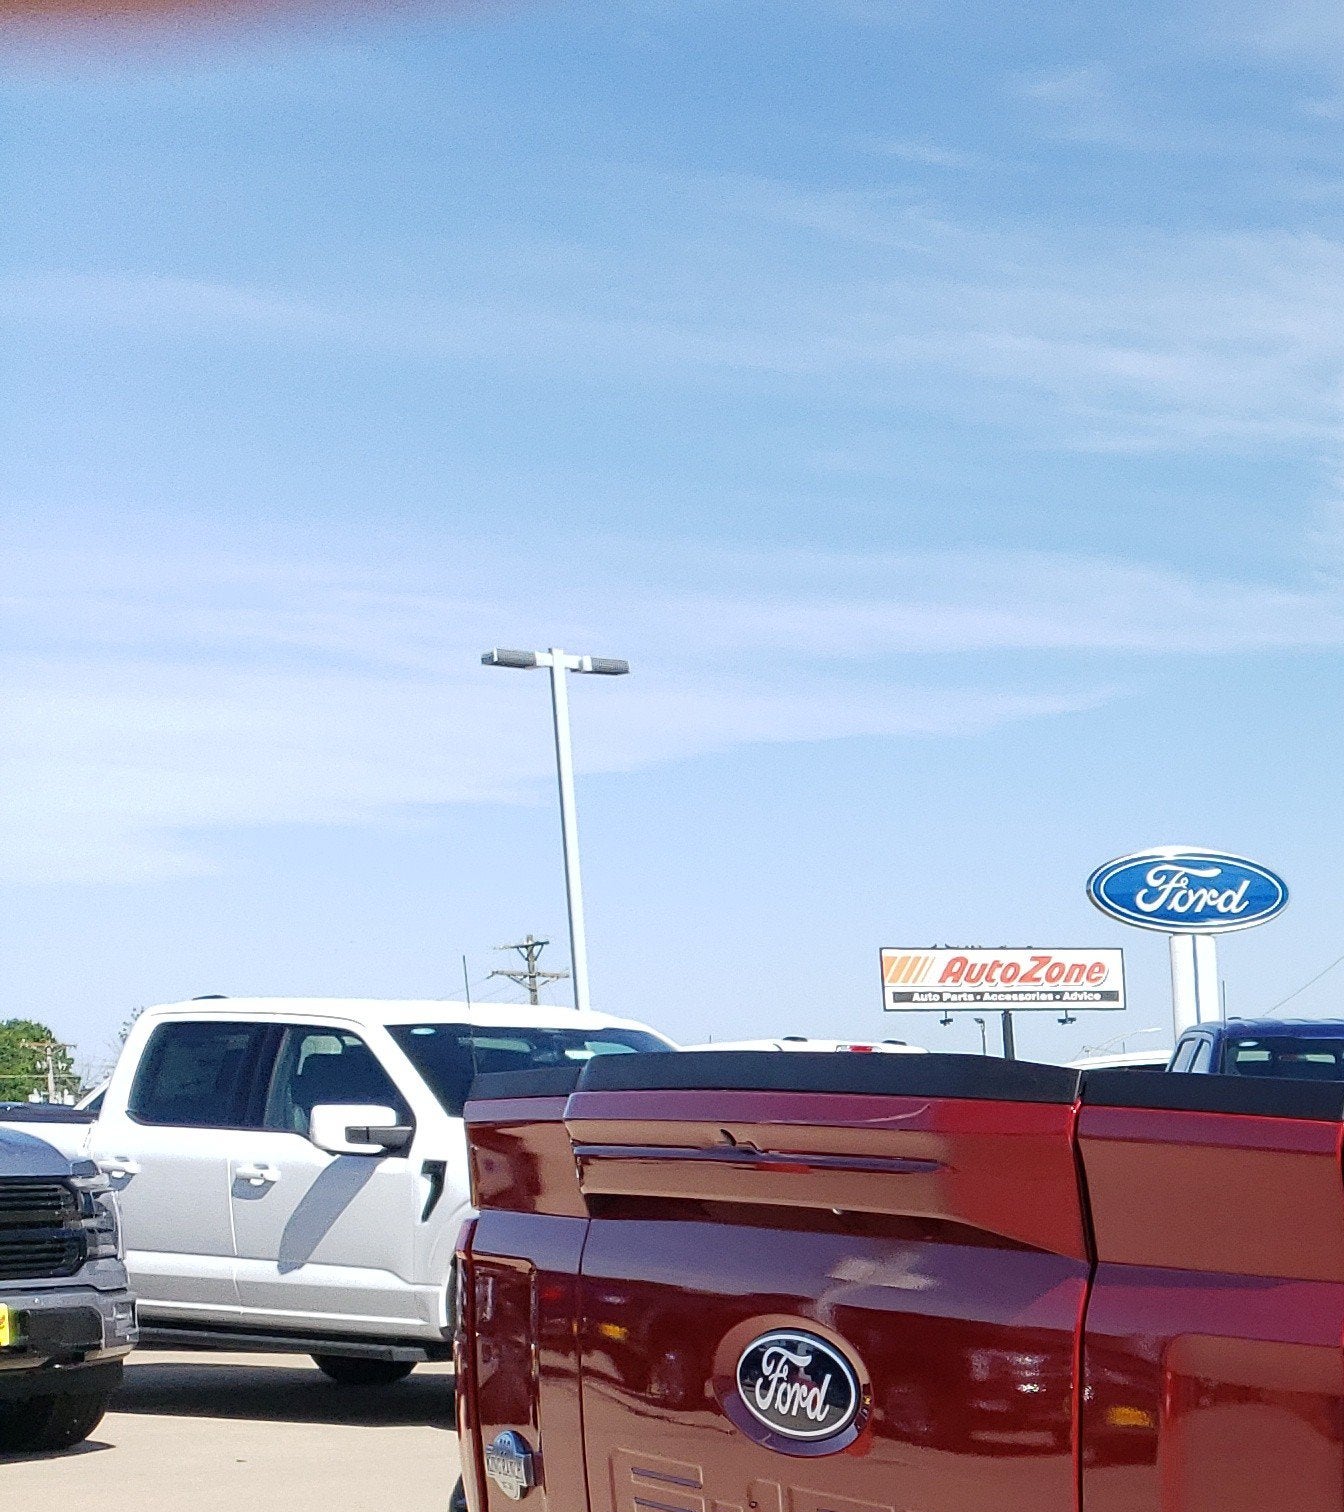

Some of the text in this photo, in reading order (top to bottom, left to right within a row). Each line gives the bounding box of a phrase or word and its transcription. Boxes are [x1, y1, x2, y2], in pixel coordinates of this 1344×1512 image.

[1134, 863, 1251, 914] Ford
[937, 955, 1108, 986] AutoZone
[912, 992, 1102, 1002] Auto Parts Accessories Advice
[754, 1346, 833, 1422] Ford
